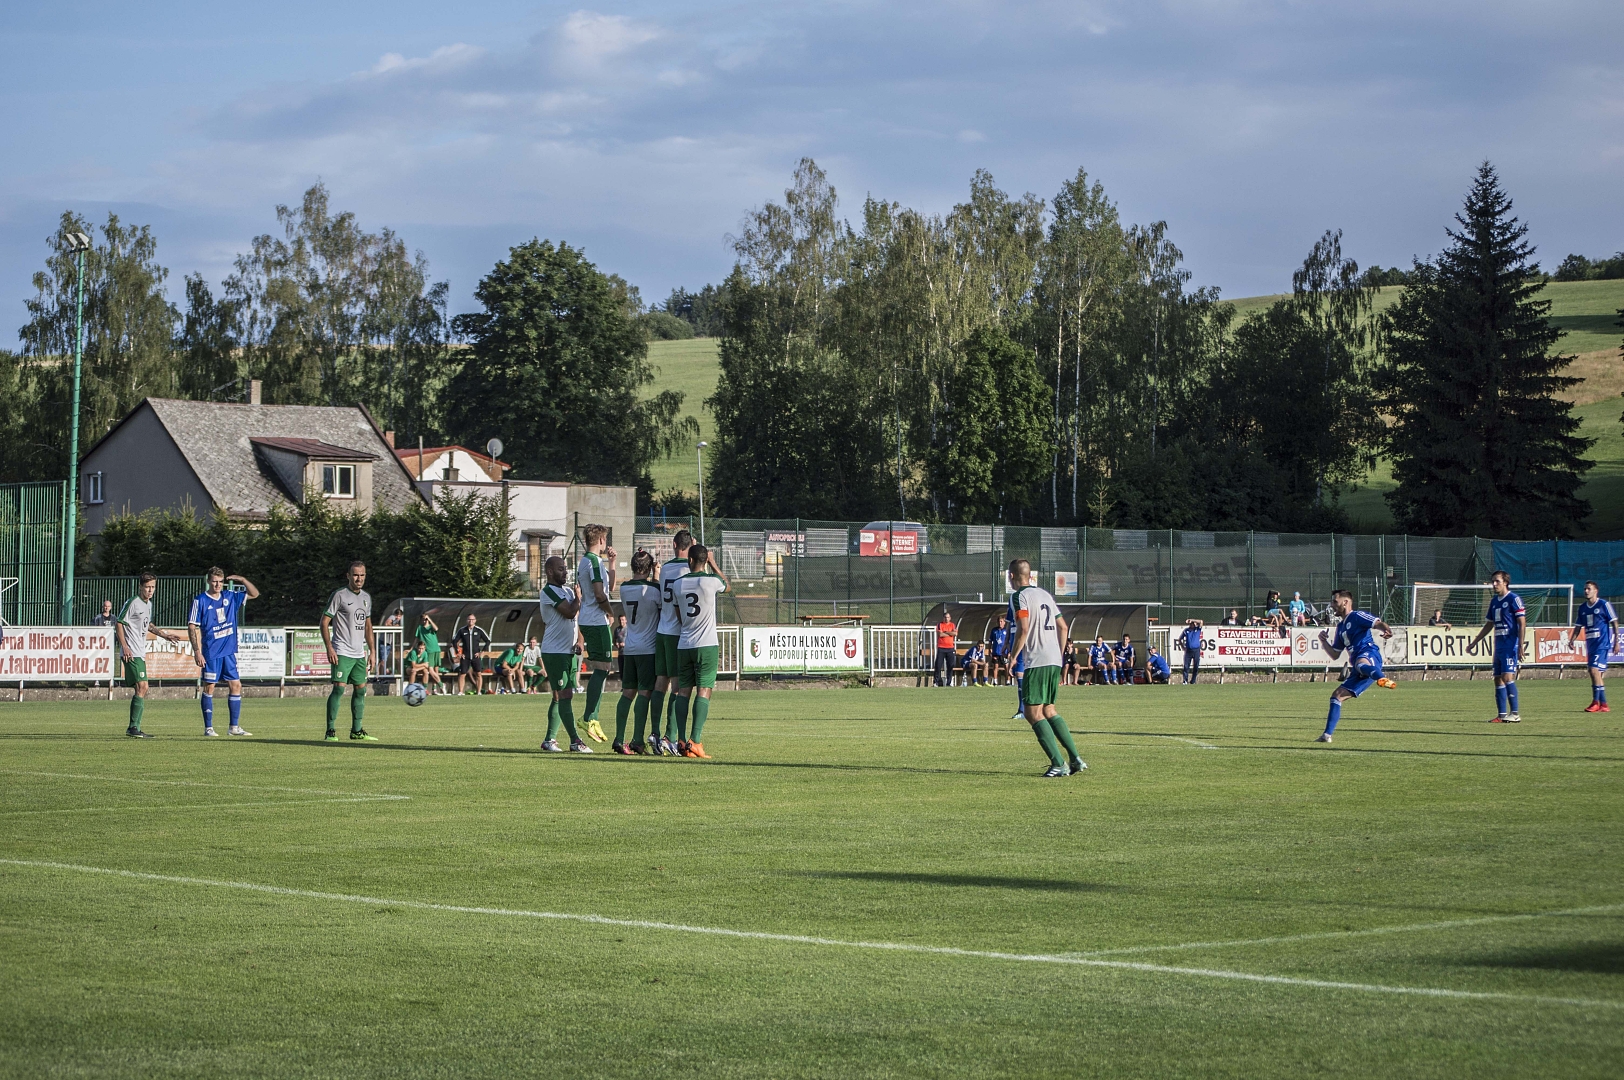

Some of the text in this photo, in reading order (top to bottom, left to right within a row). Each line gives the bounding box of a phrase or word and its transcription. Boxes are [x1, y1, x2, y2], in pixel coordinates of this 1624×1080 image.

[664, 579, 674, 602] 5
[686, 593, 700, 617] 3
[506, 609, 521, 622] D
[626, 601, 638, 624] 7
[1040, 604, 1055, 630] 2
[29, 633, 73, 650] Hlinsko
[78, 636, 110, 650] s.r.o.
[241, 631, 269, 645] JEHLIČKA,
[770, 633, 837, 647] MĚSTO HLINSKO
[1174, 639, 1216, 650] ROS
[146, 638, 195, 656] ZNICTV
[1225, 646, 1283, 655] STAVEBNINY
[769, 650, 837, 659] PODPORUJE FOTBAL
[1506, 658, 1515, 666] 10
